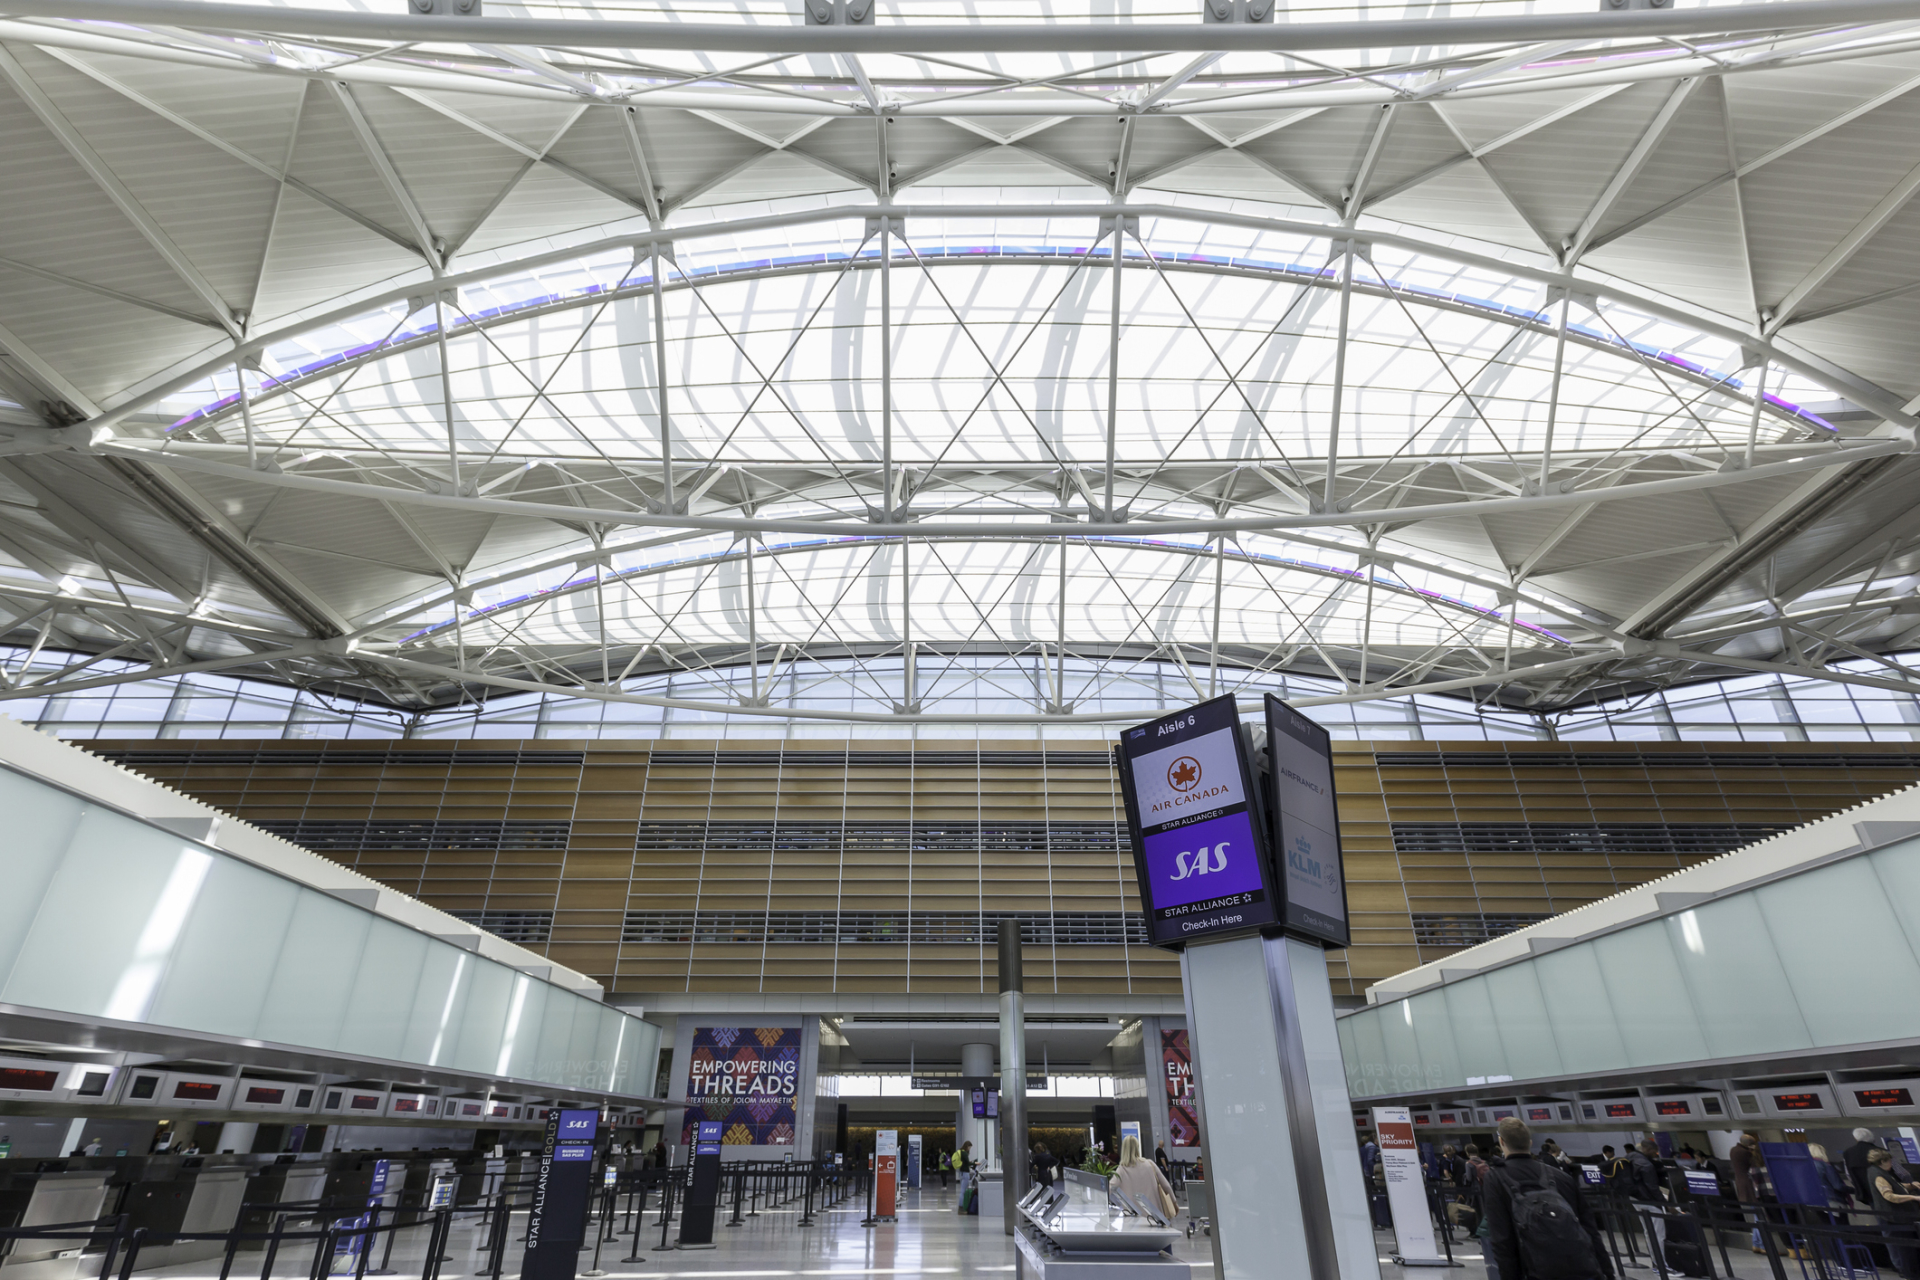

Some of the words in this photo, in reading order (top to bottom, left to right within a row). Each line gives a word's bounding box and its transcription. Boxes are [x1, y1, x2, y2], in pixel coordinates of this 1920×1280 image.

[1157, 720, 1186, 737] Aisle
[1187, 715, 1196, 726] 6
[1290, 716, 1306, 733] Aisle
[1306, 725, 1312, 736] 7
[1280, 767, 1319, 794] AIRFRANCE
[1151, 800, 1172, 813] AIR
[1174, 784, 1229, 806] CANADA
[1162, 819, 1181, 831] STAR
[1181, 810, 1218, 826] ALLIANCE
[1170, 842, 1231, 881] SAS
[1288, 850, 1322, 879] KLM
[1165, 905, 1189, 918] STAR
[1191, 896, 1241, 913] ALLIANCE
[1182, 917, 1219, 932] Check-In
[1220, 913, 1243, 928] Here
[1303, 914, 1323, 929] Check-In
[1323, 921, 1335, 932] Here
[692, 1060, 796, 1074] EMPOWERING
[691, 1075, 795, 1095] THREADS
[690, 1096, 719, 1104] TEXTILES
[720, 1096, 731, 1104] OF
[733, 1096, 757, 1104] JOLOM
[759, 1096, 793, 1104] MAYAETIK
[544, 1122, 557, 1154] GOLD
[689, 1129, 699, 1166] ALLIANCE
[534, 1157, 551, 1215] ALLIANCE
[686, 1167, 695, 1187] STAR
[1586, 1171, 1602, 1179] EXIT
[528, 1217, 541, 1248] STAR
